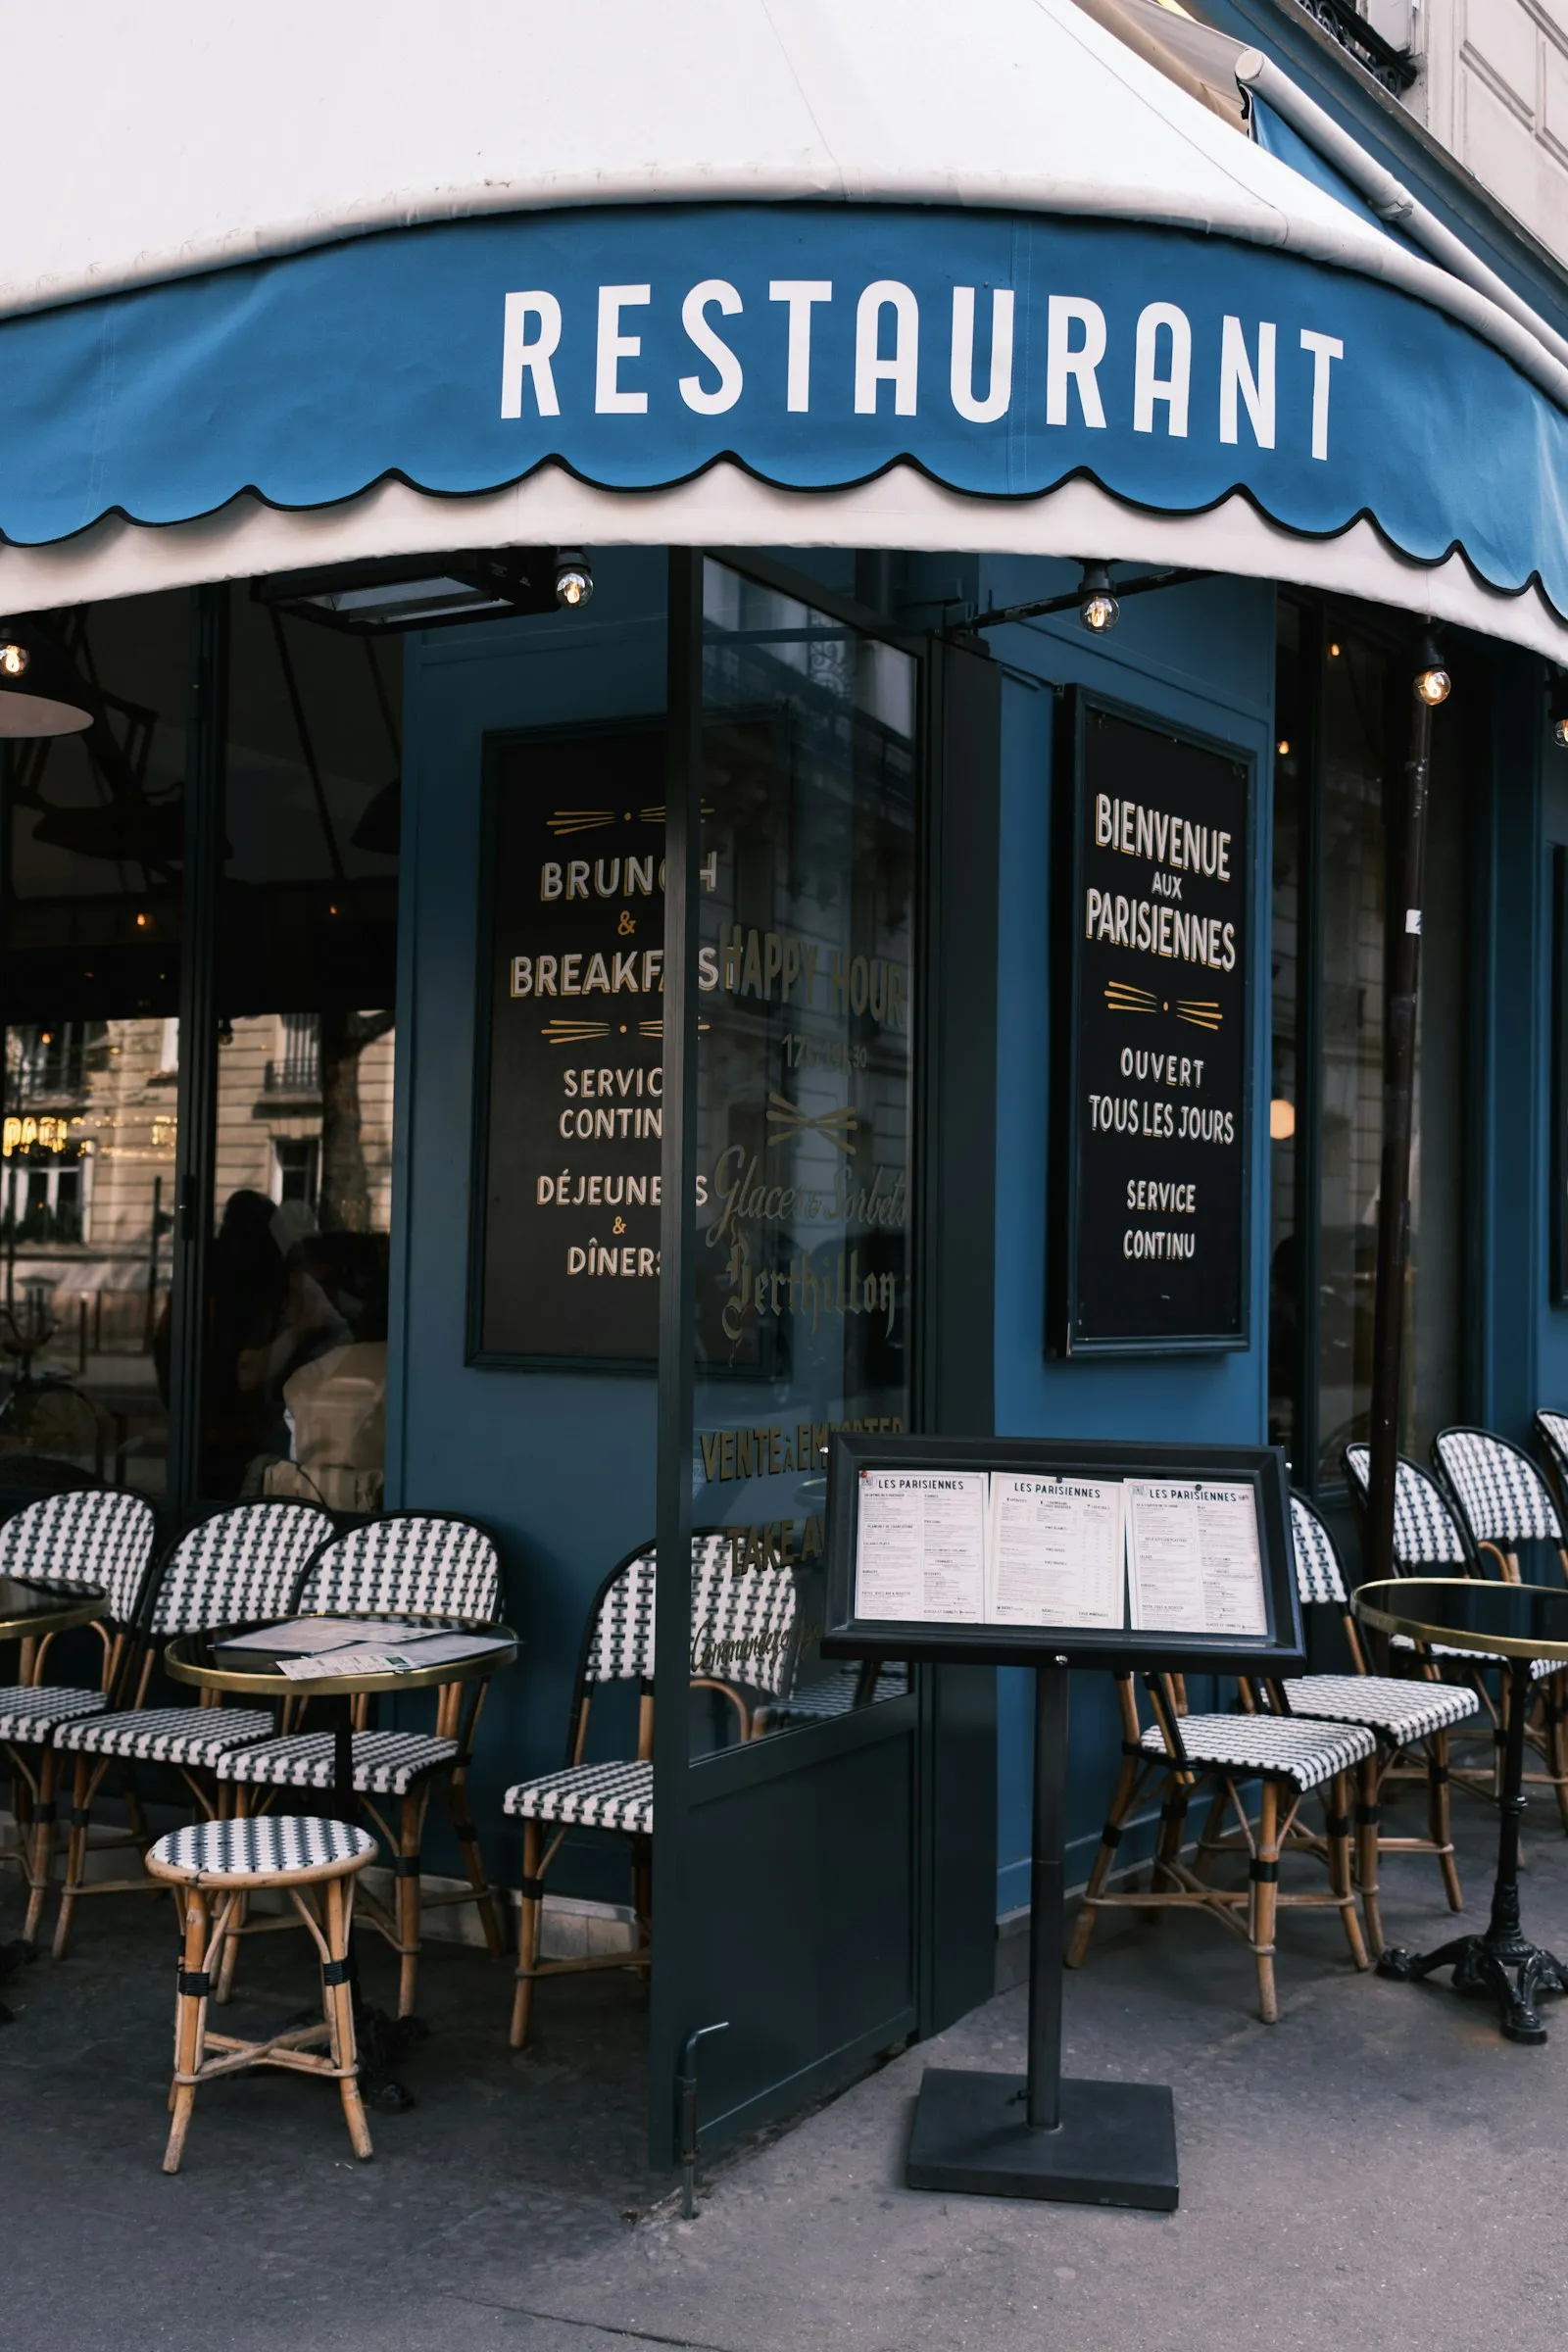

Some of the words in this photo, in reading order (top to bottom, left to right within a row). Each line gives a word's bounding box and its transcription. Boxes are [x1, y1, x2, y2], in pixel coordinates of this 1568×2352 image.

[500, 278, 1345, 461] RESTAURANT
[1095, 793, 1232, 883] BIENVENUE
[1152, 872, 1182, 900] AUX
[617, 910, 636, 936] &
[1085, 888, 1236, 972] PARISIENNES
[718, 922, 818, 1005] HAPPY
[829, 949, 908, 1028] HOUR
[563, 1066, 662, 1099] SERVIC
[1120, 1047, 1204, 1087] OUVERT
[559, 1107, 662, 1140] CONTIN
[1089, 1095, 1139, 1134] TOUS
[1143, 1101, 1174, 1138] LES
[1178, 1105, 1235, 1145] JOURS
[536, 1168, 709, 1206] DÉJEUNES
[1127, 1179, 1197, 1213] SERVICE
[612, 1215, 627, 1235] &
[1123, 1229, 1195, 1259] CONTINU
[566, 1237, 661, 1277] DÎNER
[721, 1221, 896, 1366] Berthillon
[700, 1428, 781, 1483] VENTE
[878, 1479, 896, 1489] LES
[899, 1479, 964, 1491] PARISIENNES
[1014, 1482, 1032, 1493] LES
[1035, 1484, 1102, 1498] PARISIENNES
[1150, 1489, 1168, 1498] LES
[1170, 1491, 1237, 1502] PARISIENNES
[725, 1518, 795, 1579] TAKE
